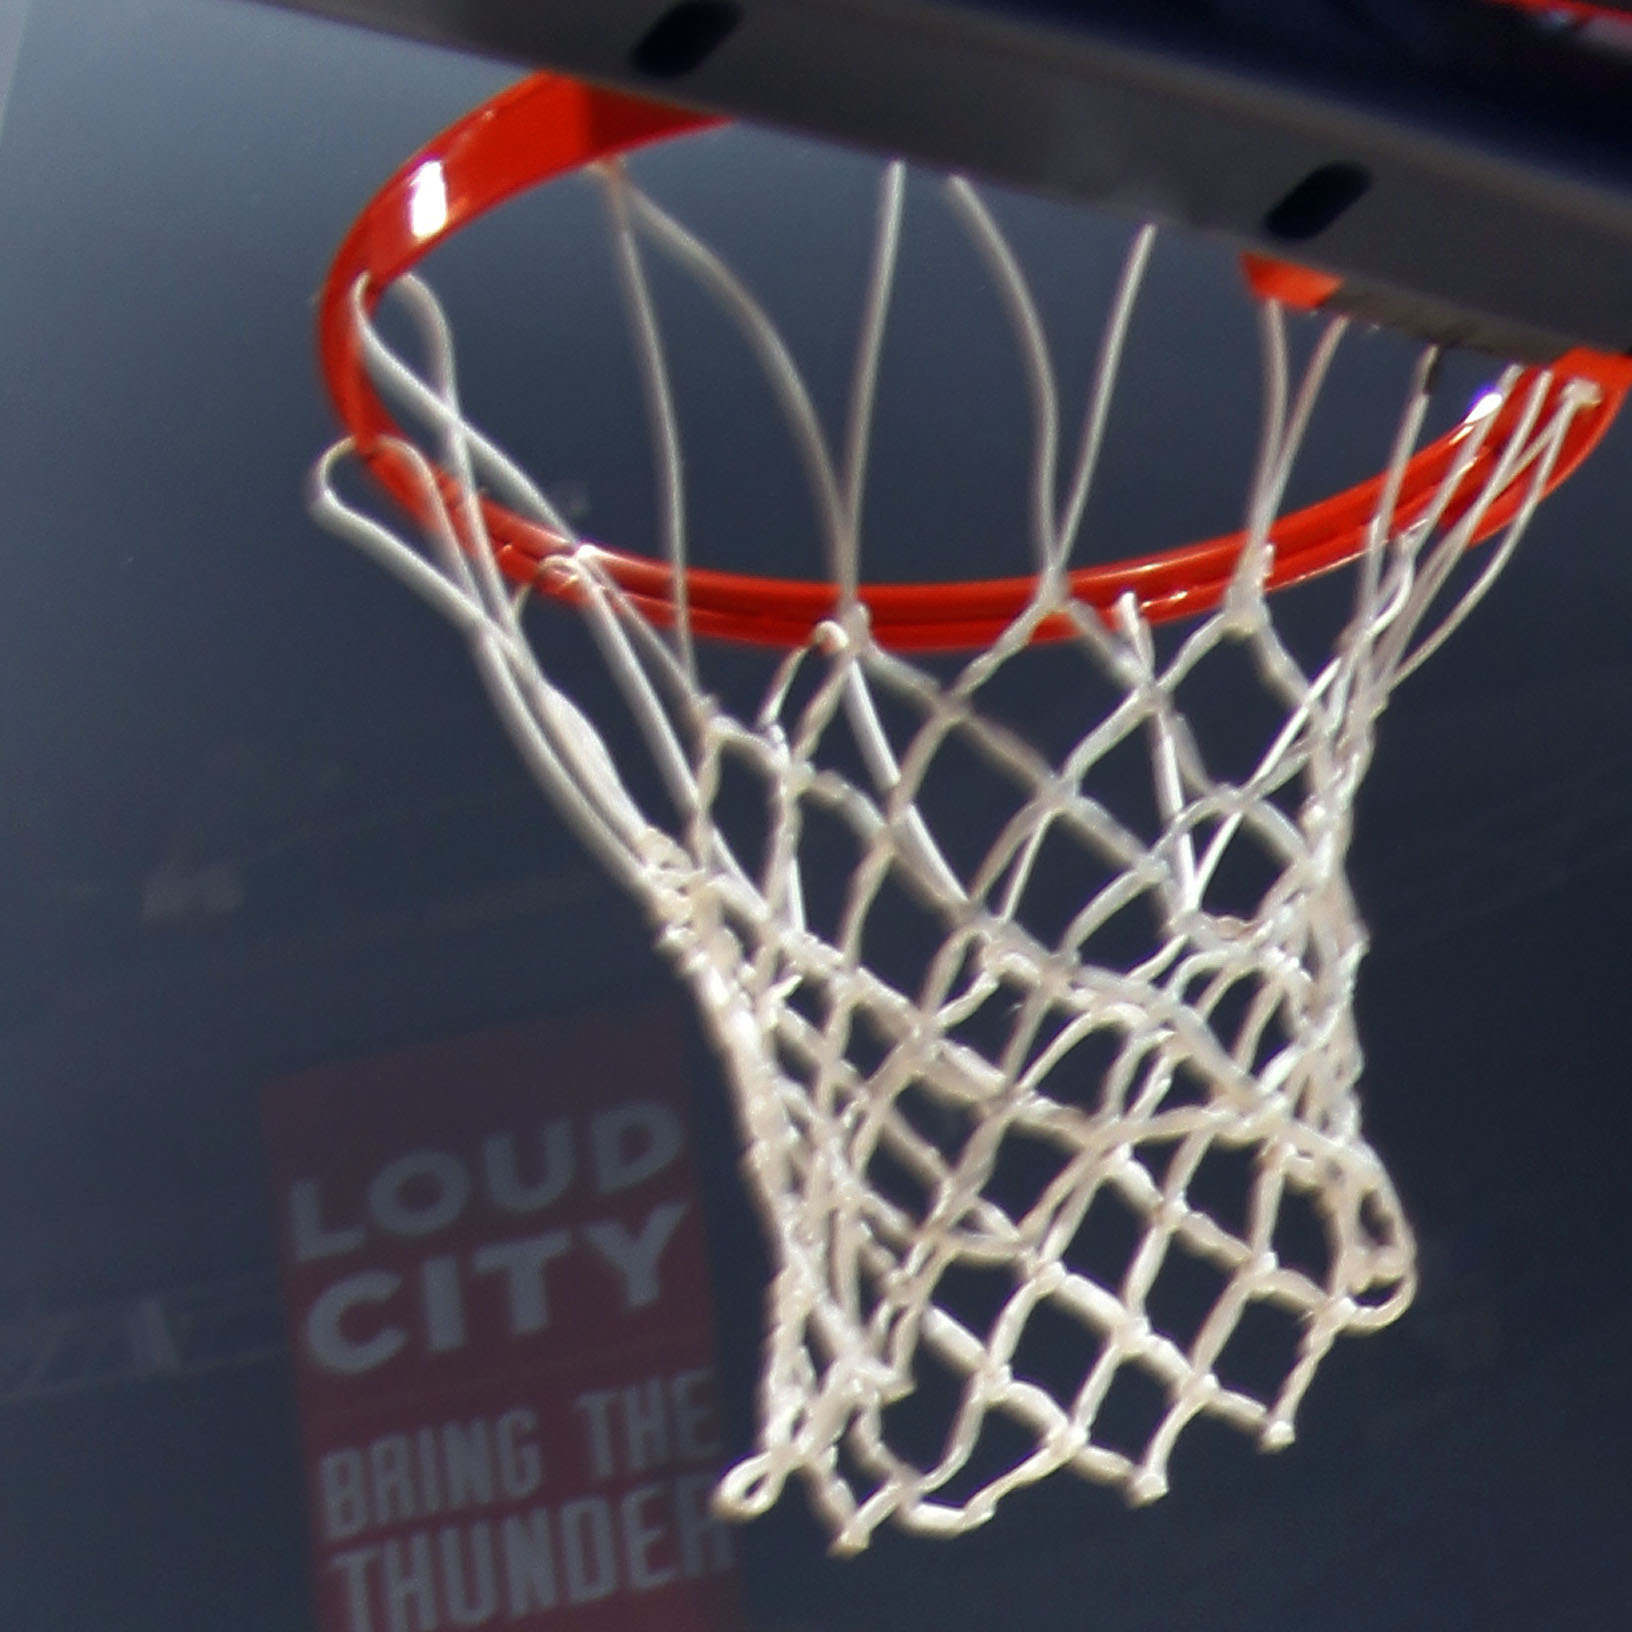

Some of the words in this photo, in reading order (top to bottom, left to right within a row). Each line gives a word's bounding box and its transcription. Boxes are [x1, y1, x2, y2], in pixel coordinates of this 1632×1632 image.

[288, 1100, 684, 1261] LOUD
[305, 1204, 687, 1374] CITY
[320, 1410, 543, 1540] BRING
[575, 1370, 721, 1480] THE
